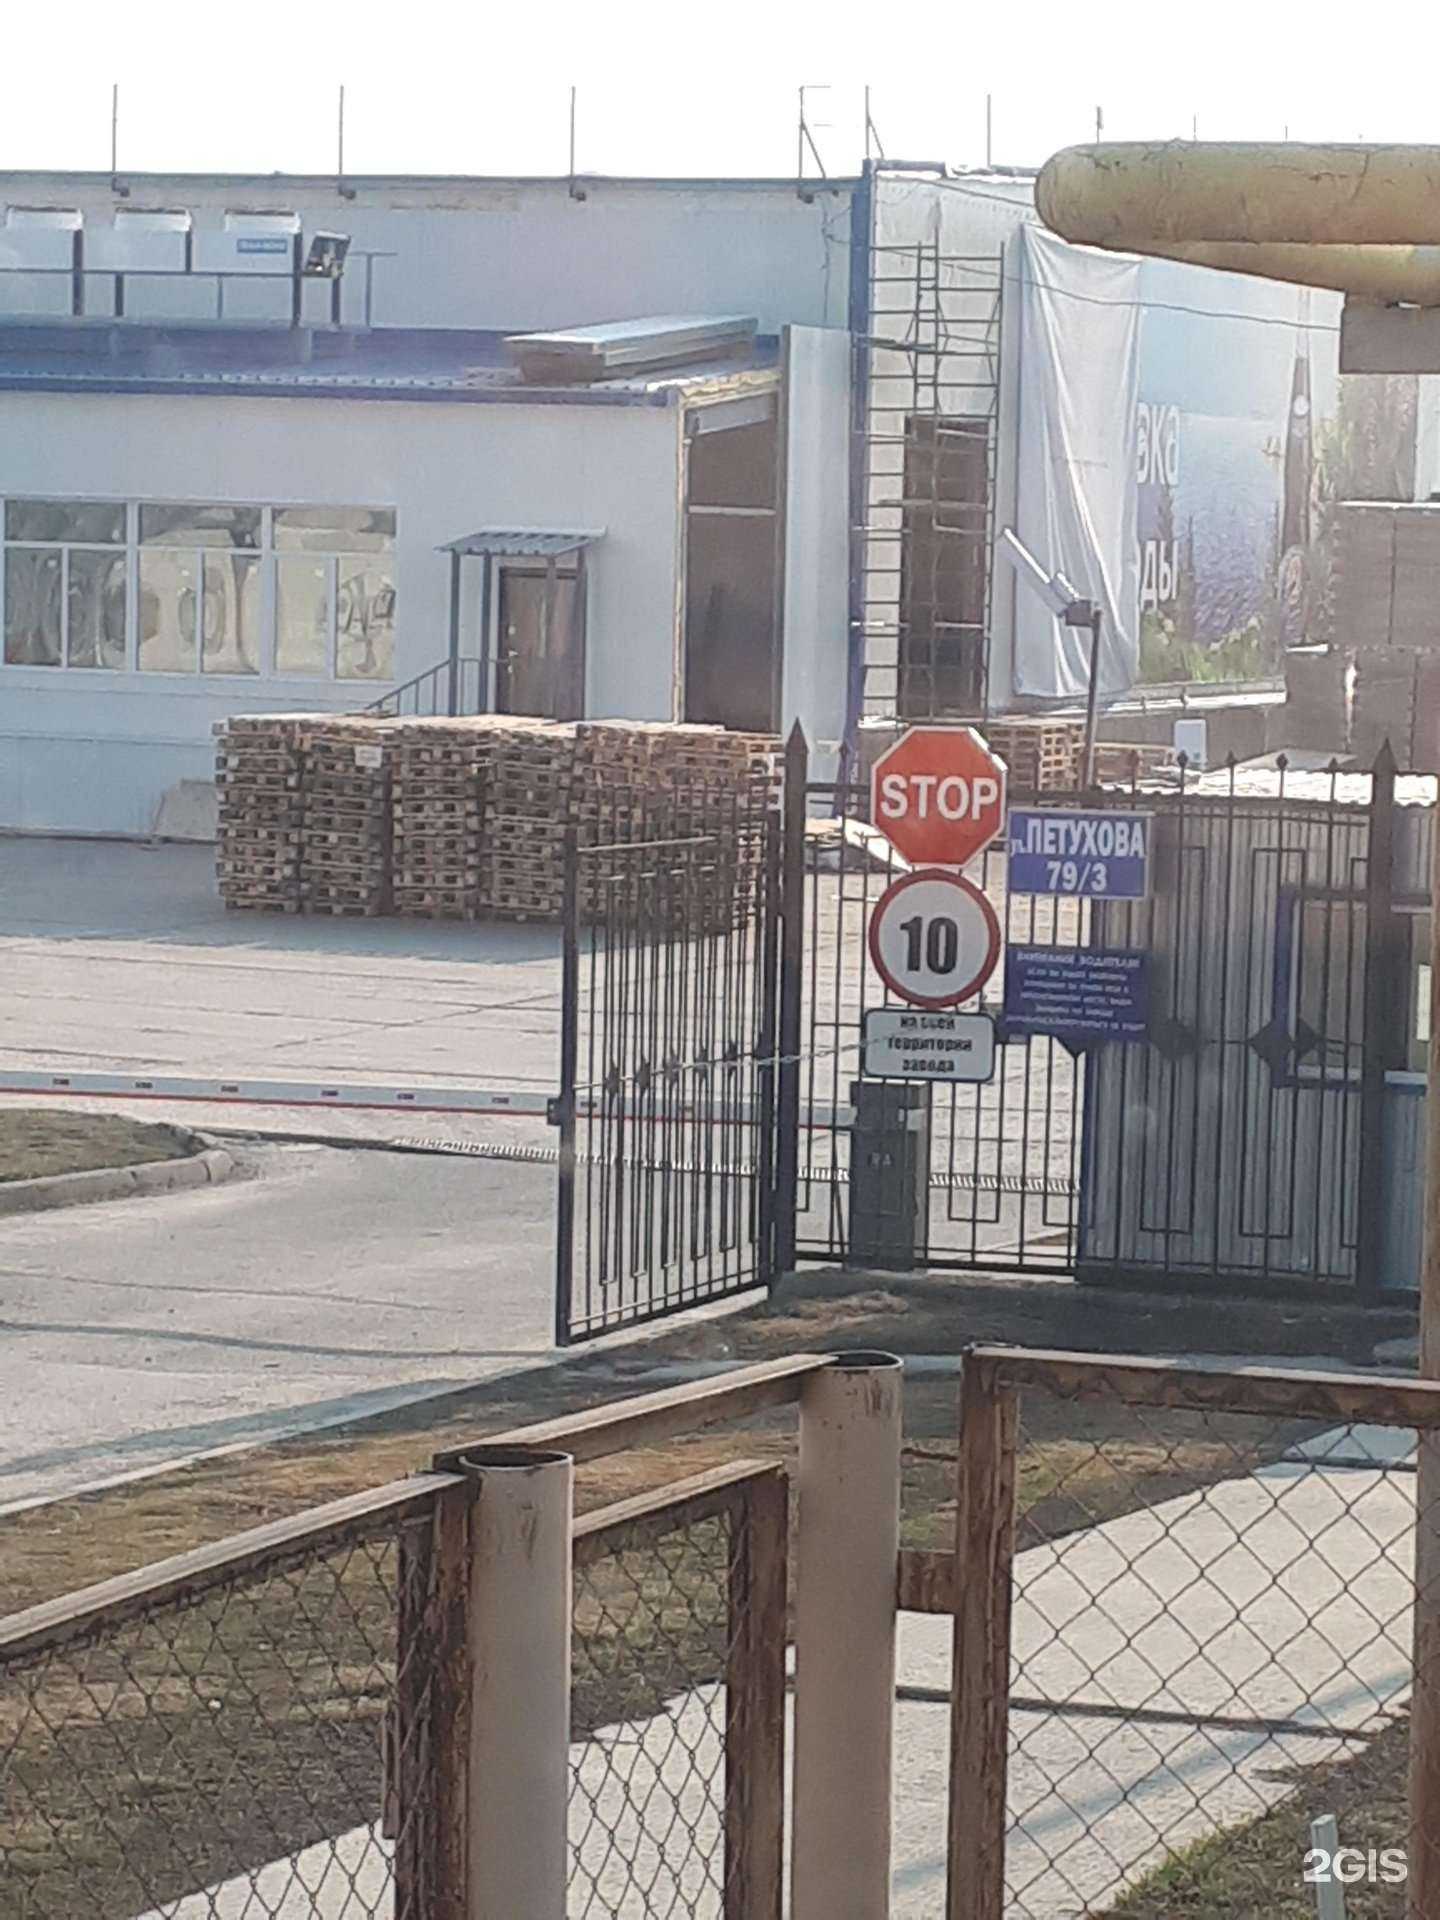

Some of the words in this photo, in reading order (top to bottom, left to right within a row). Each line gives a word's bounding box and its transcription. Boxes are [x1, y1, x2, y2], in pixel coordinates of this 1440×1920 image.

[880, 774, 998, 820] STOP
[1046, 860, 1107, 892] 79/3
[900, 916, 958, 975] 10
